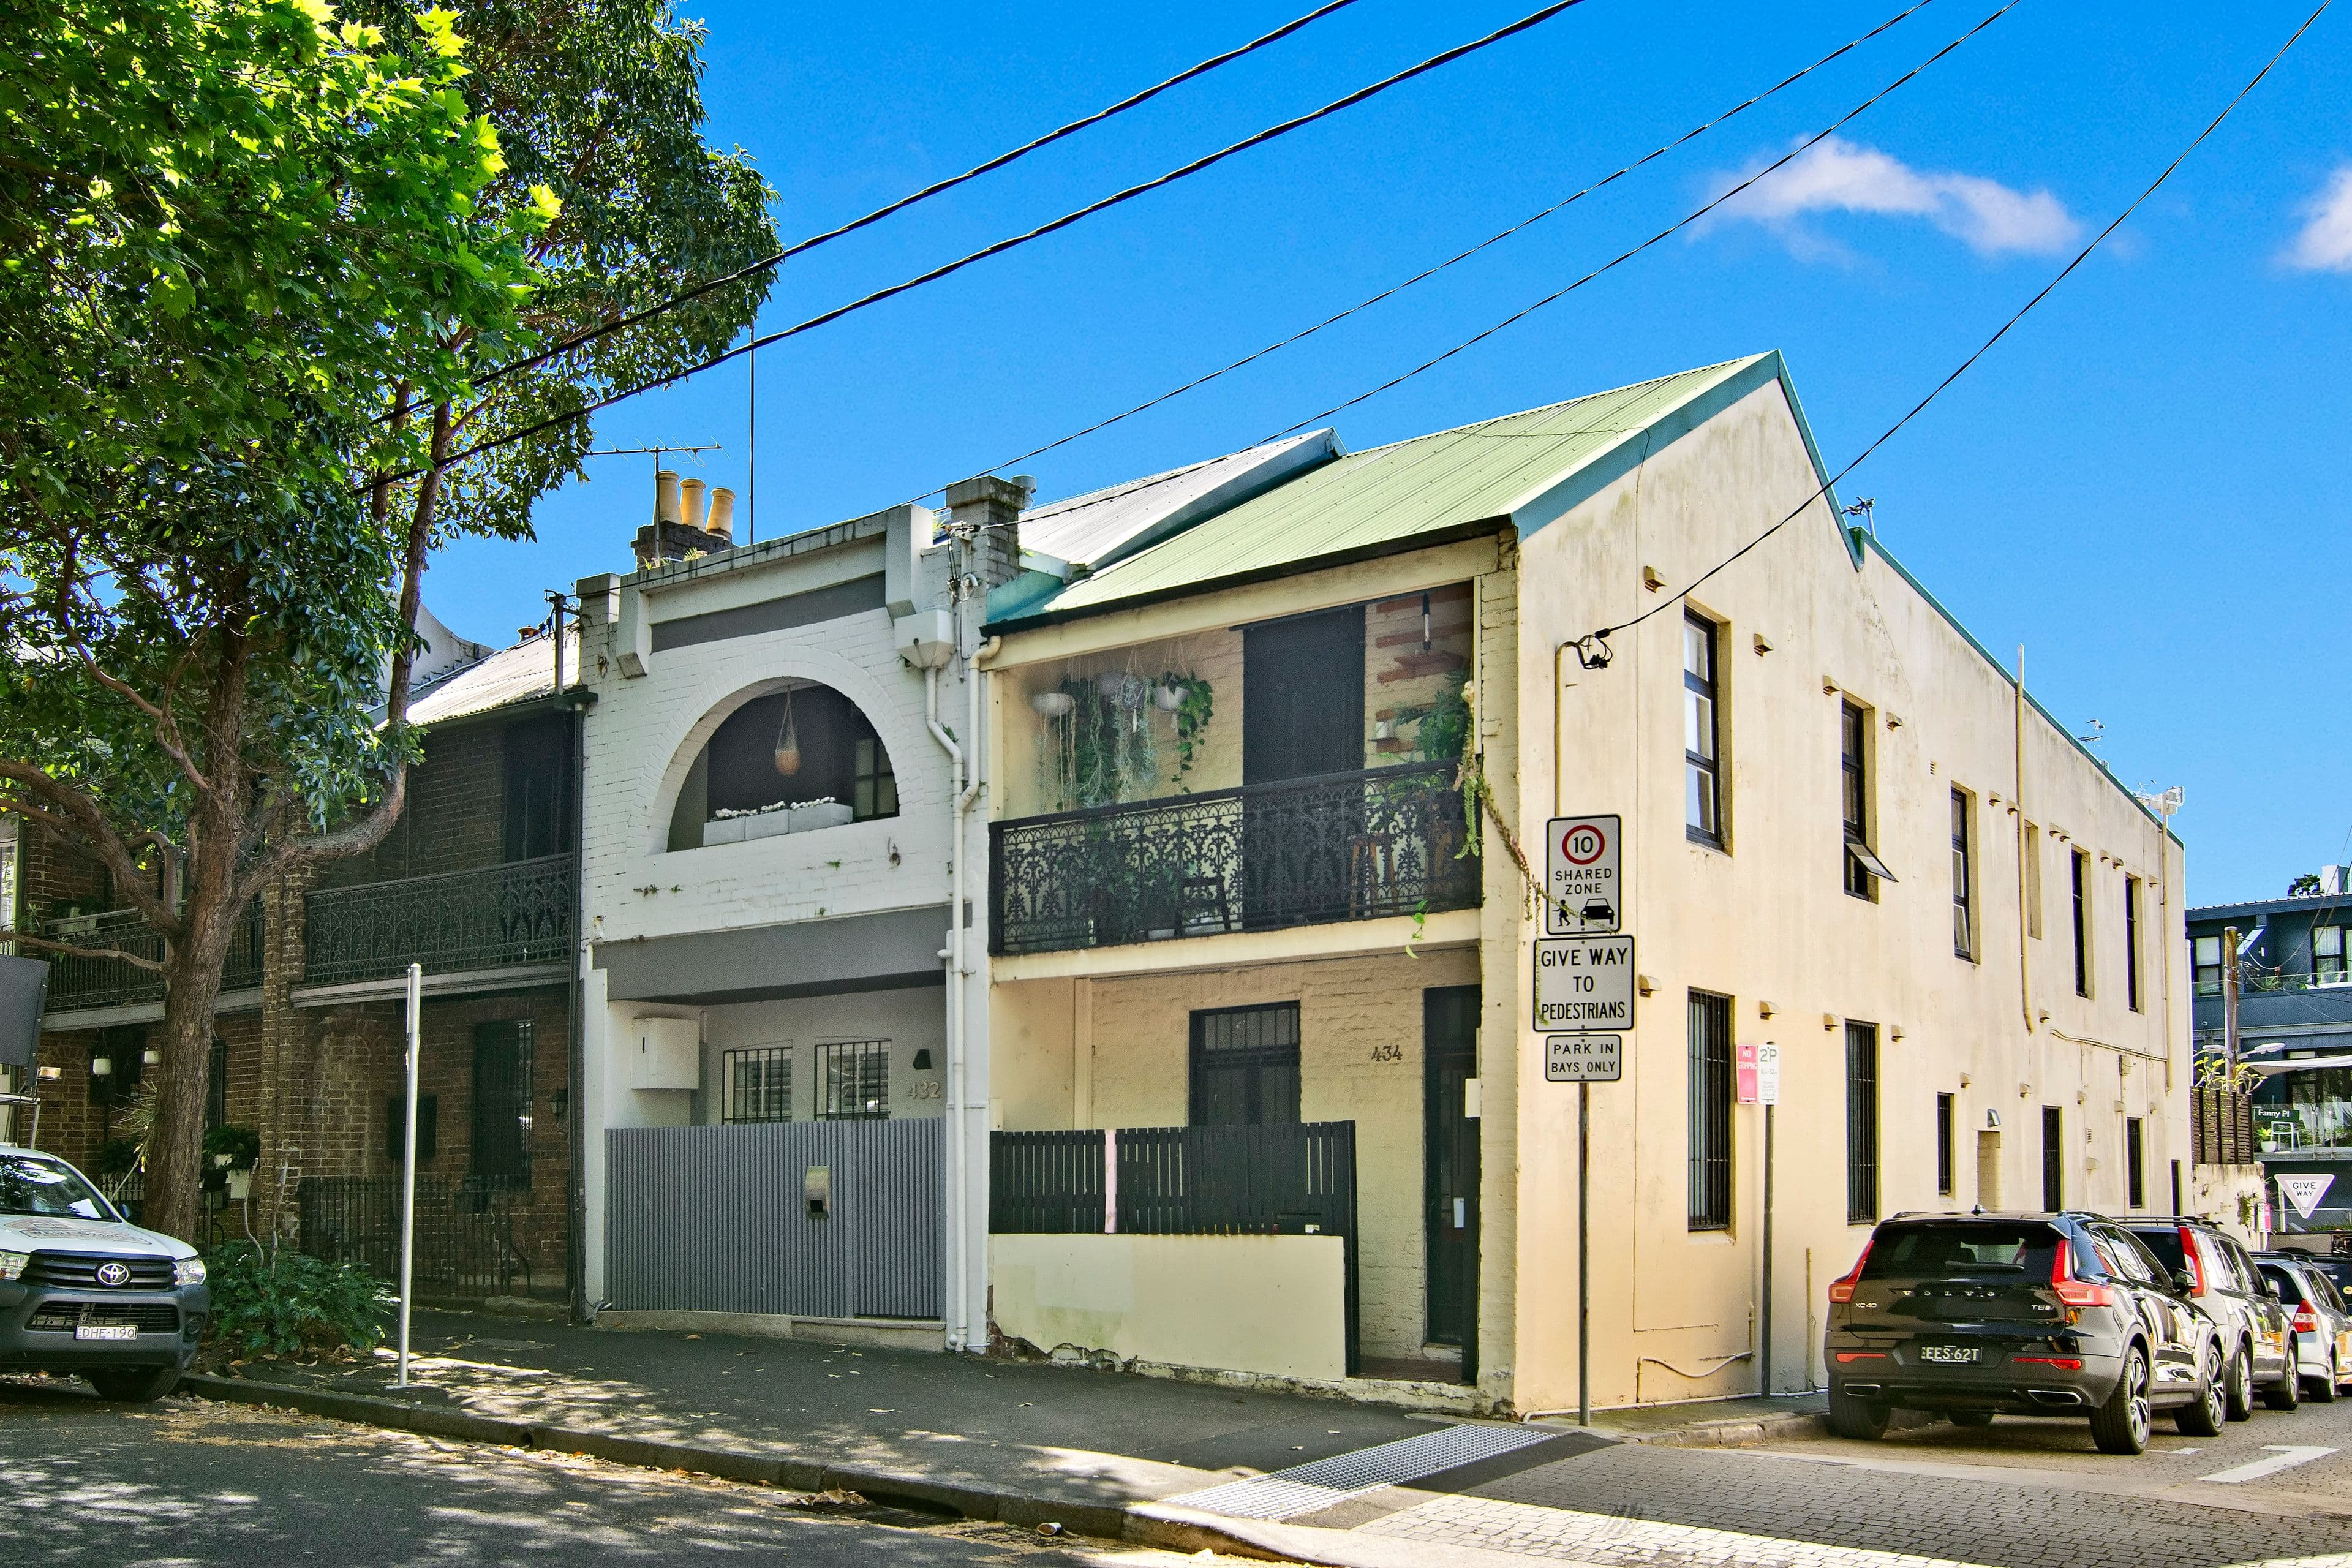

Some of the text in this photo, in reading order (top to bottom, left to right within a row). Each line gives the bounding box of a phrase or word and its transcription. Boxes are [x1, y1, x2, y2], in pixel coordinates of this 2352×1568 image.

[1573, 836, 1594, 854] 10
[1555, 868, 1612, 881] SHARED
[1565, 883, 1602, 895] ZONE
[1541, 947, 1628, 967] GIVE WAY
[1573, 976, 1594, 992] TO
[1541, 1001, 1625, 1020] PEDESTRIANS
[1371, 1044, 1403, 1062] 434
[1553, 1043, 1614, 1055] PARK IN
[1742, 1049, 1752, 1058] NO
[1760, 1049, 1777, 1063] 2P
[1551, 1061, 1616, 1072] BAYS ONLY
[907, 1081, 941, 1100] 432
[2258, 1109, 2280, 1118] Fanny
